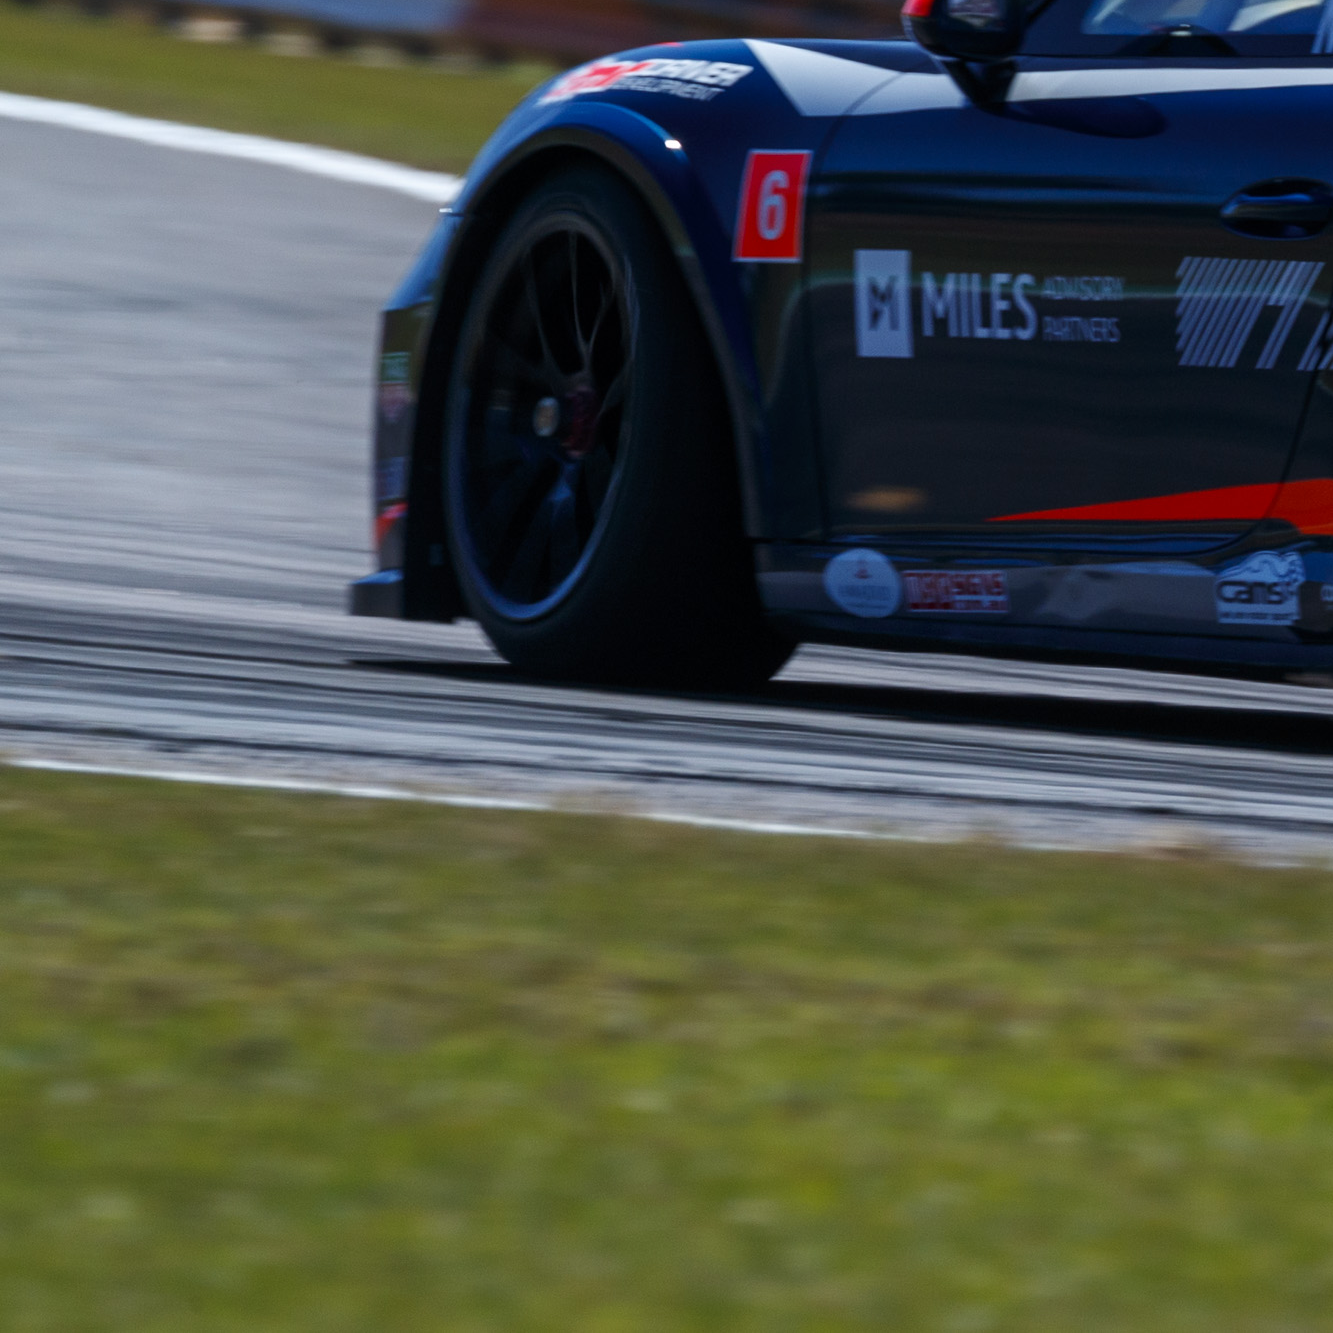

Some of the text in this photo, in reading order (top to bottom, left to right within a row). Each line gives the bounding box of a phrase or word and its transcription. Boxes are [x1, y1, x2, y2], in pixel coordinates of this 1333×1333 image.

[755, 170, 789, 241] 6
[920, 271, 1038, 341] MILES
[1042, 315, 1122, 343] PARTNERS
